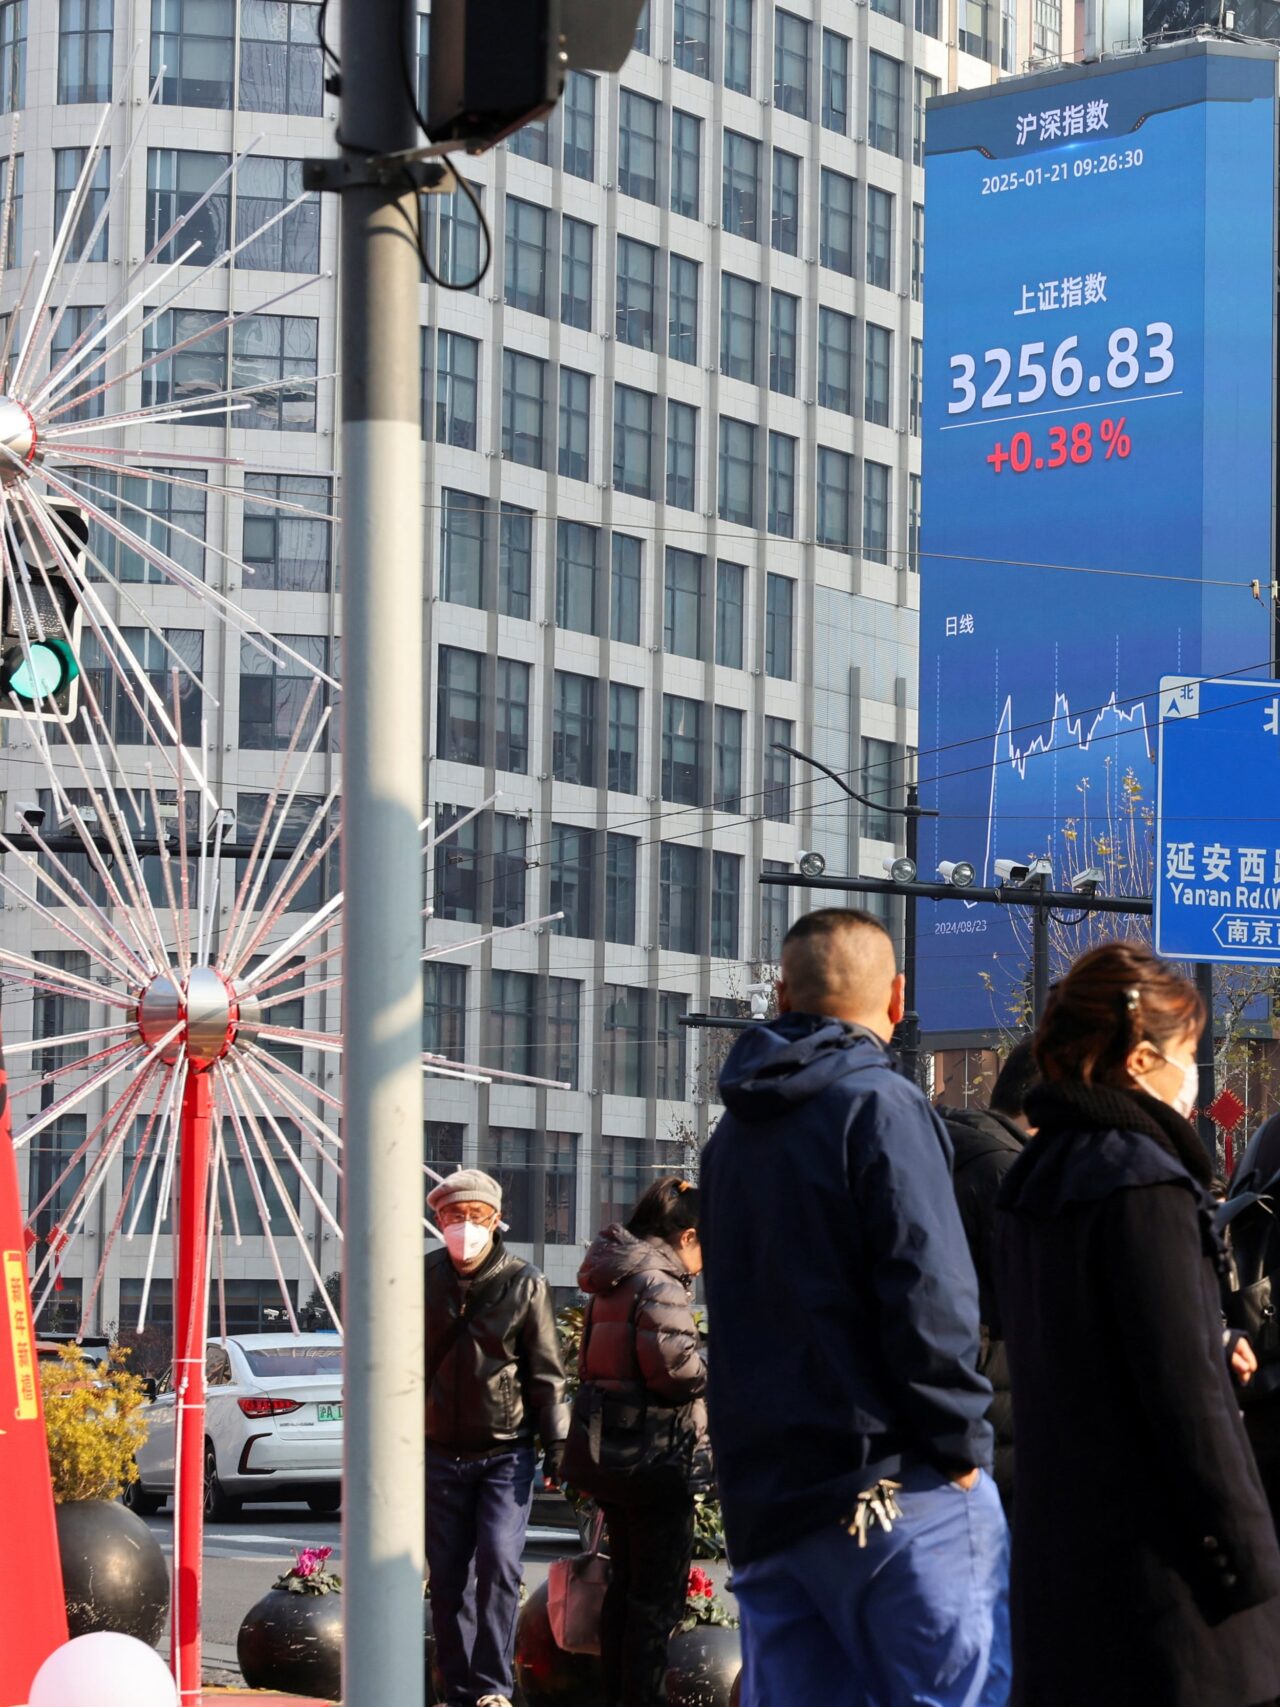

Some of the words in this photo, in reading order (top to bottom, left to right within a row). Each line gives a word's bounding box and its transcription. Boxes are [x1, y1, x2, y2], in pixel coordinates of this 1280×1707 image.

[1015, 99, 1109, 145] 沪深指数
[981, 160, 1068, 195] 2025-01-21
[1073, 148, 1143, 179] 09:26:30
[1013, 271, 1108, 316] 上证指数
[948, 321, 1176, 415] 3256.83
[986, 417, 1132, 474] +0.38%
[945, 613, 975, 637] 日线
[1180, 684, 1194, 700] 北
[1170, 881, 1231, 908] Yan'an
[935, 919, 987, 935] 2024/08/23
